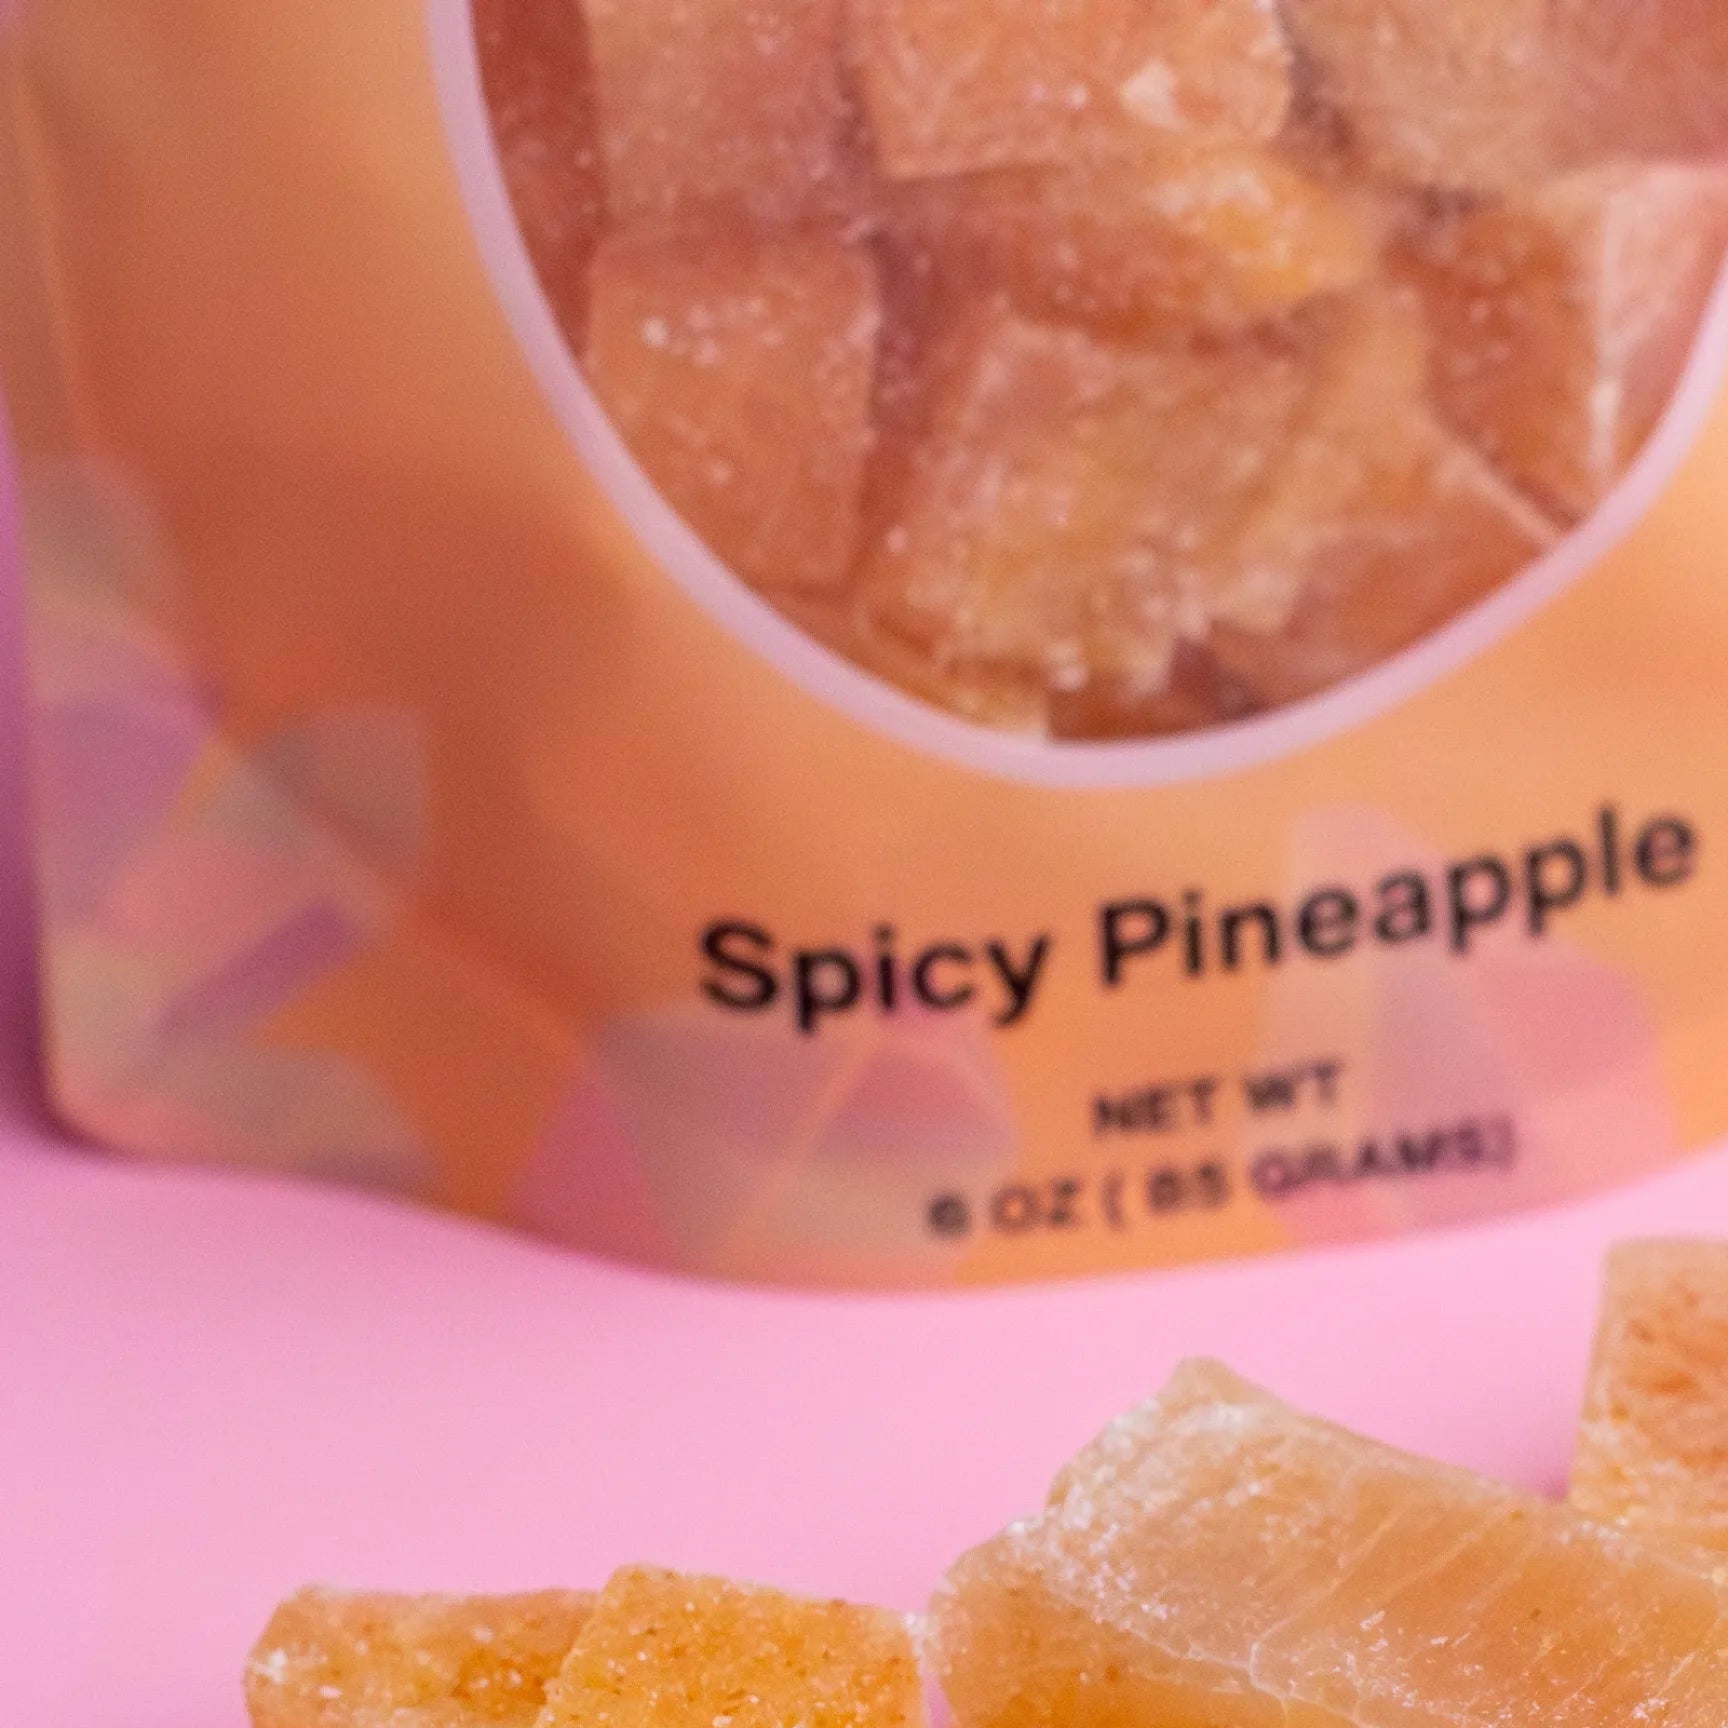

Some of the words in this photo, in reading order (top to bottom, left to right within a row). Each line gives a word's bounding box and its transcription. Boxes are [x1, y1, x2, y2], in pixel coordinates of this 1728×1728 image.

[698, 915, 1050, 1032] Spicy
[1098, 803, 1698, 990] Pineapple
[1092, 1074, 1218, 1138] NET
[1244, 1056, 1345, 1112] WT
[990, 1176, 1083, 1234] OZ
